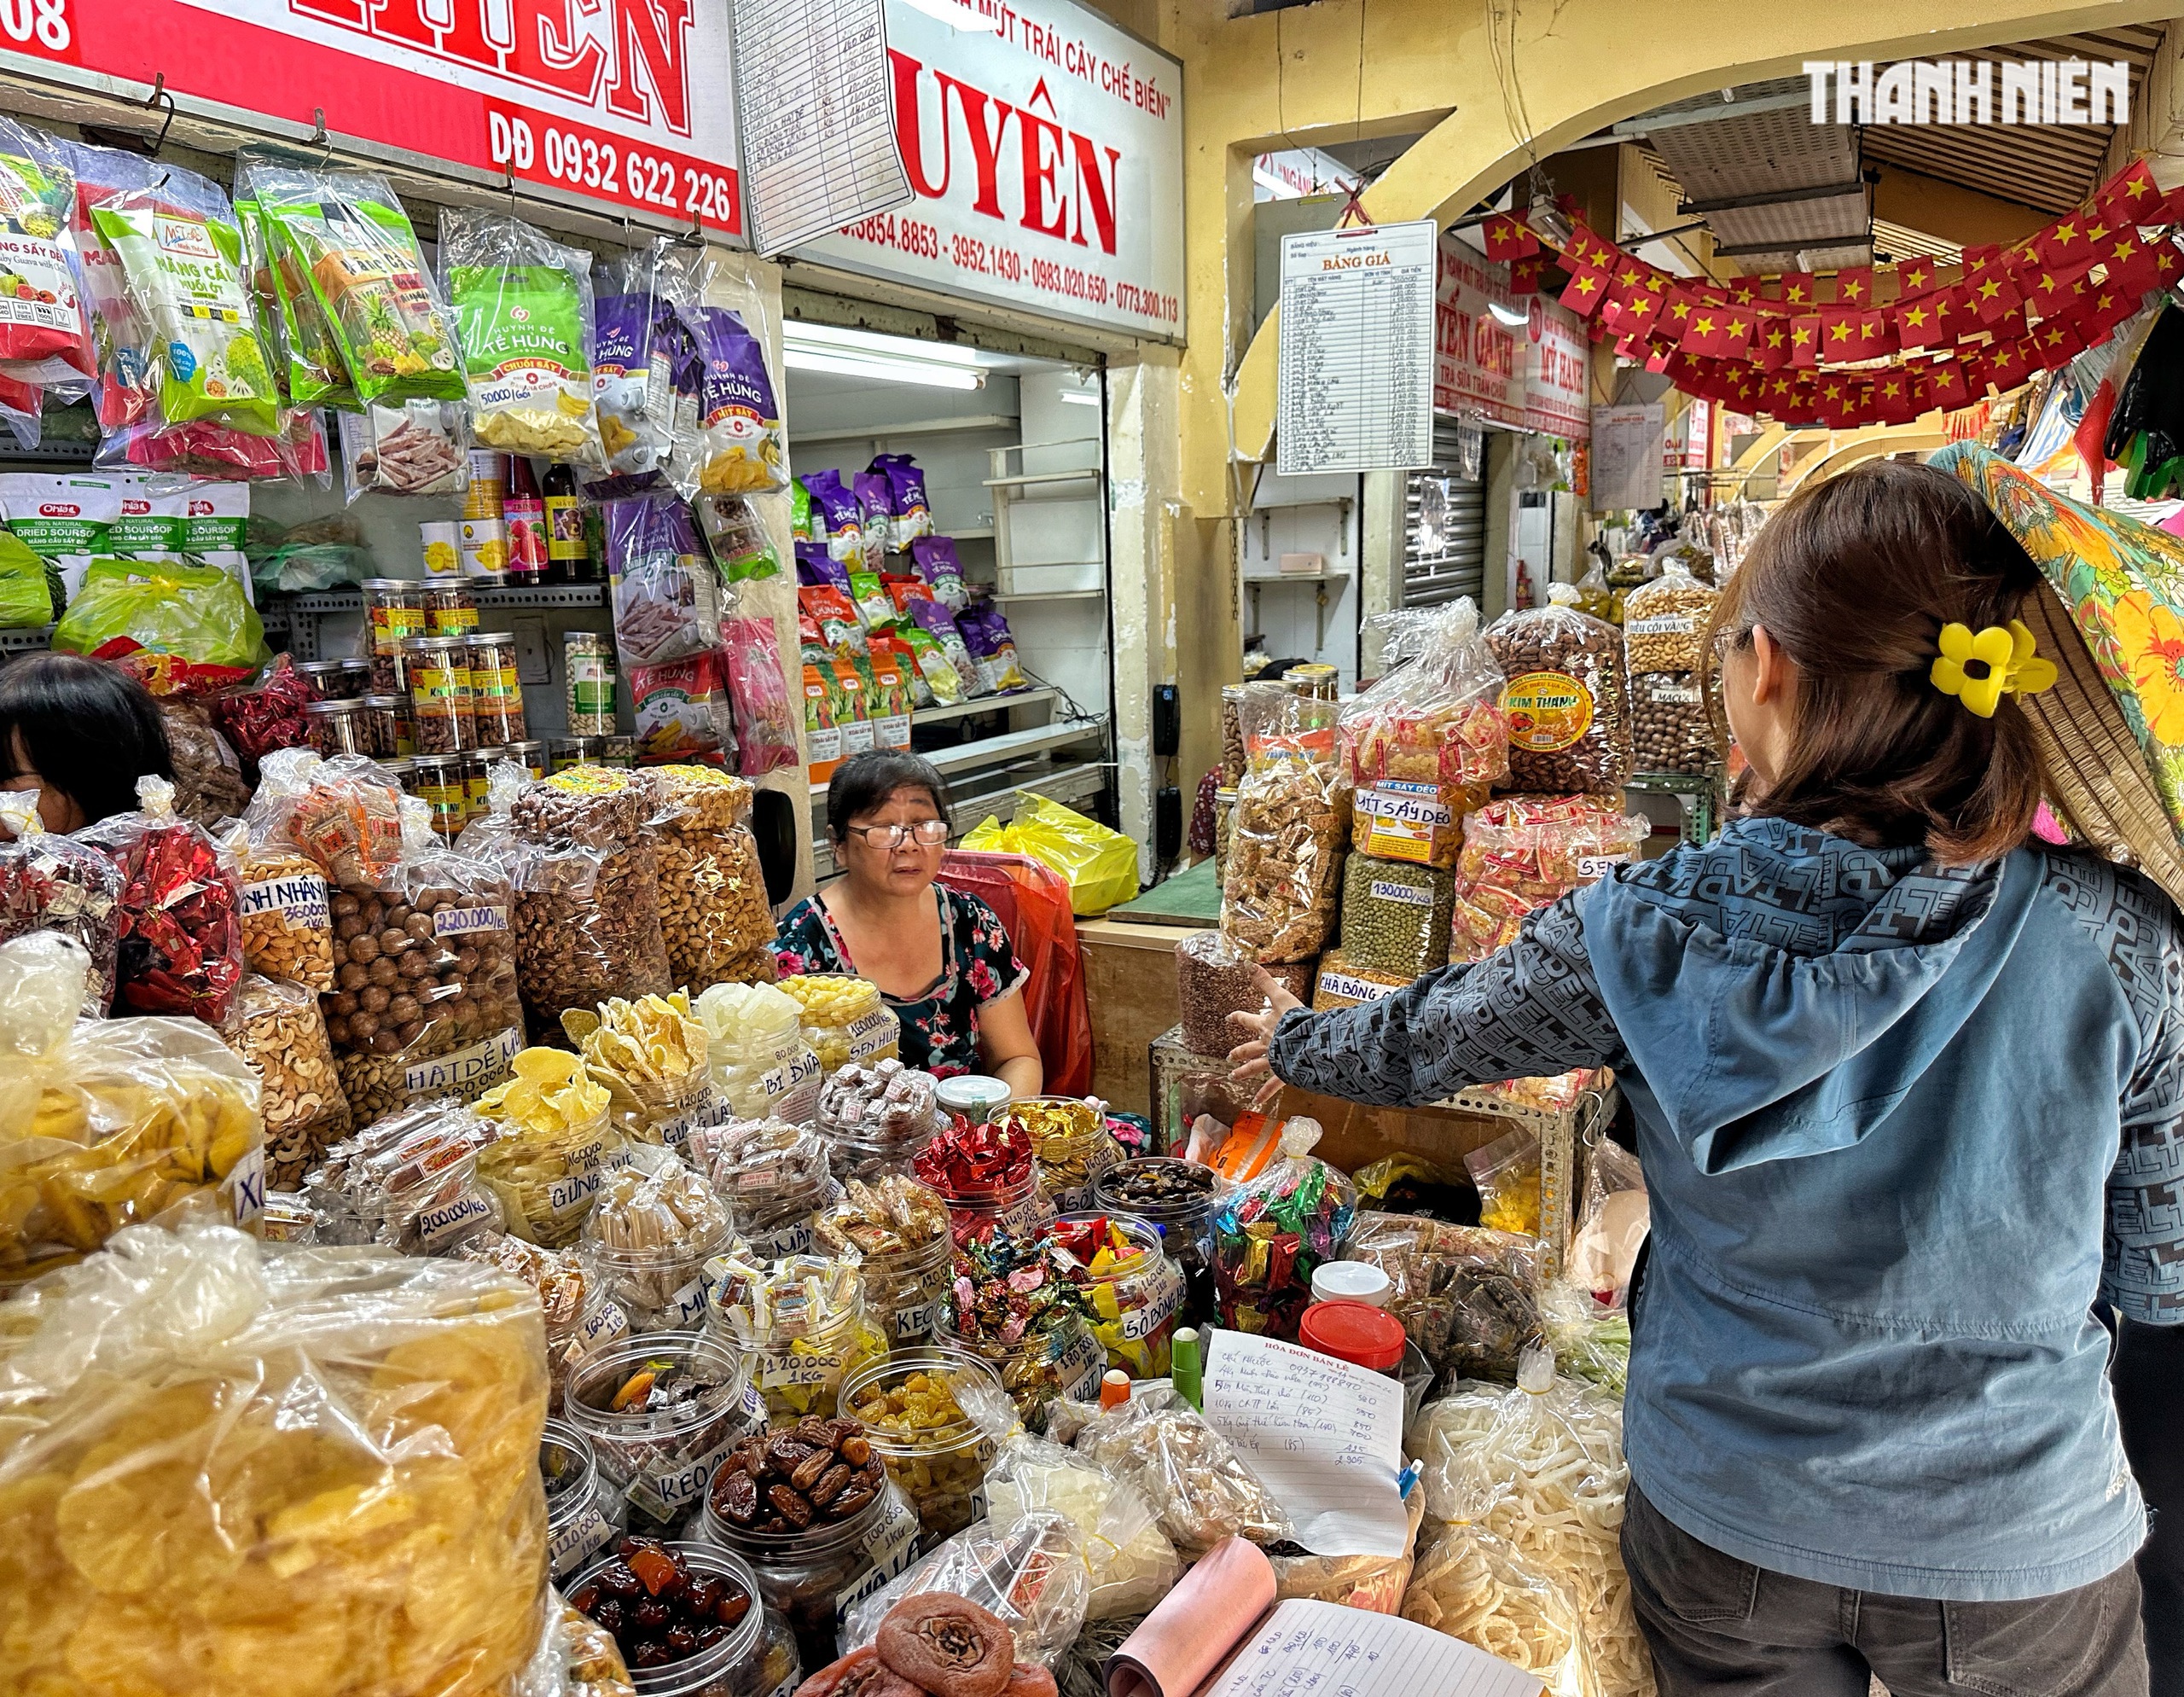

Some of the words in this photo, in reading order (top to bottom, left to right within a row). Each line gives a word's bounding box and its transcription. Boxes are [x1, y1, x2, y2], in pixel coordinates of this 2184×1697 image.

[1021, 17, 1061, 67] TRÁI
[1066, 40, 1097, 84] CÂY
[1101, 61, 1131, 102] CHẾ
[489, 111, 535, 171] DĐ
[543, 127, 621, 195] 0932
[626, 152, 678, 209] 622
[683, 168, 731, 222] 226
[1322, 253, 1362, 271] BẢNG
[1365, 251, 1391, 266] GIÁ
[951, 235, 1022, 283] 3952.1430
[1031, 258, 1108, 305] 0983.020.650
[1115, 282, 1179, 324] 0773.300.113
[720, 379, 763, 404] HÙNG
[16, 528, 48, 538] DRIED
[49, 528, 96, 539] SOURSOP
[125, 525, 173, 535] SOURSOP
[192, 526, 237, 535] SOURSOP
[1508, 696, 1533, 709] KIM
[1535, 695, 1577, 708] THANH
[1375, 780, 1392, 789] MÍT
[1416, 782, 1438, 795] DẺO
[1355, 793, 1382, 812] MÍT
[1421, 805, 1451, 826] DẺO
[276, 875, 324, 905] NHÂN
[1320, 974, 1340, 993] CHÀ
[1341, 979, 1377, 1001] BÔNG
[850, 1039, 876, 1061] SEN
[408, 1061, 460, 1090] HẠT
[765, 1066, 785, 1095] BÍ
[1124, 1308, 1149, 1340] SÔ
[1151, 1296, 1176, 1328] BÔNG
[1263, 1341, 1287, 1355] HÓA
[1288, 1346, 1311, 1362] ĐƠN
[1312, 1353, 1335, 1369] BÁN
[1335, 1362, 1350, 1373] LẺ
[787, 1371, 827, 1384] 1KG
